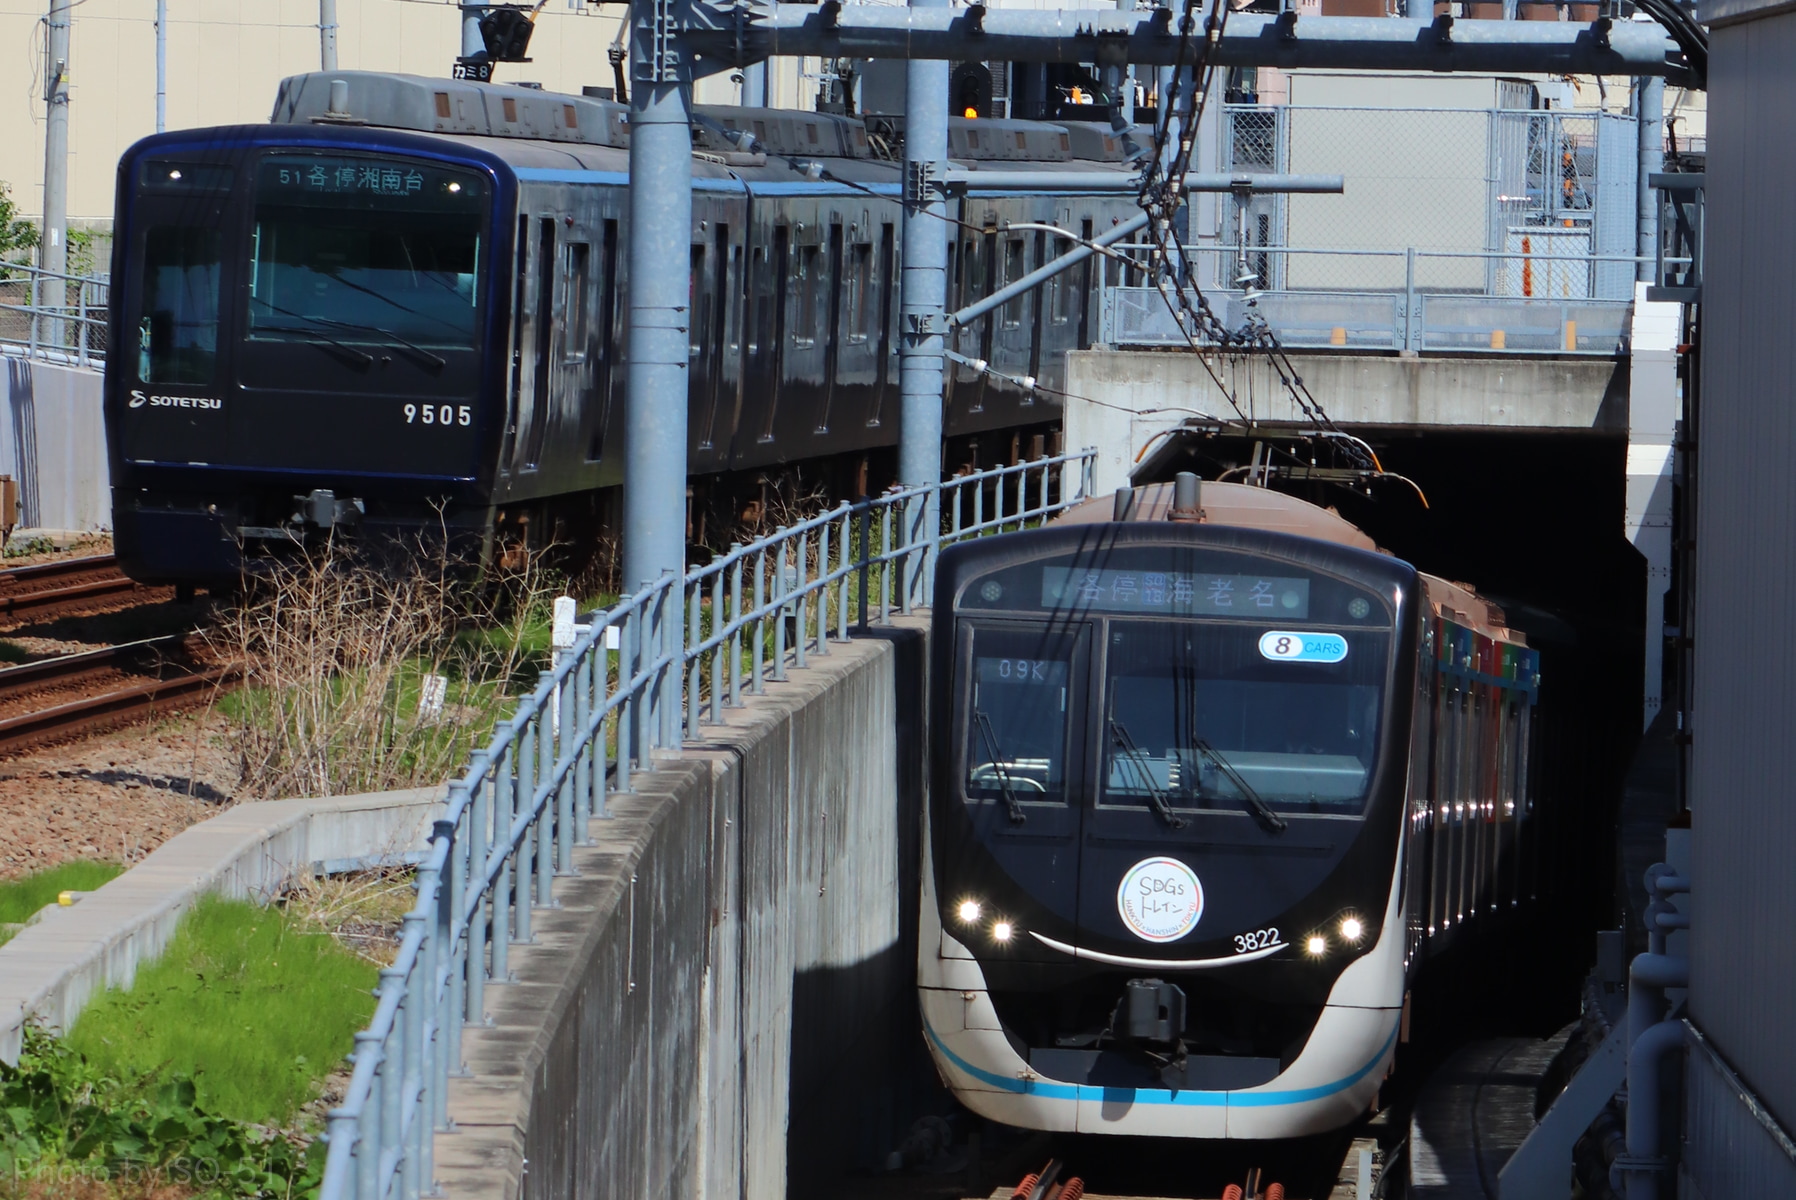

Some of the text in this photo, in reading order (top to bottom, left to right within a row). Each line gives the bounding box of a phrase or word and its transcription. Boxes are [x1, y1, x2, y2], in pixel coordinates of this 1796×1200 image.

[357, 167, 424, 190] 湘南台
[149, 395, 222, 409] SOTETSU
[403, 403, 471, 426] 9505
[1166, 576, 1275, 608] 海老名
[1275, 637, 1342, 655] 8 CARS
[1000, 659, 1044, 680] 09K
[1139, 876, 1184, 896] SDGs
[1141, 896, 1183, 919] トレイン
[1145, 924, 1179, 936] HANSHIN
[1181, 901, 1196, 925] TOKYU
[1234, 927, 1281, 953] 3822
